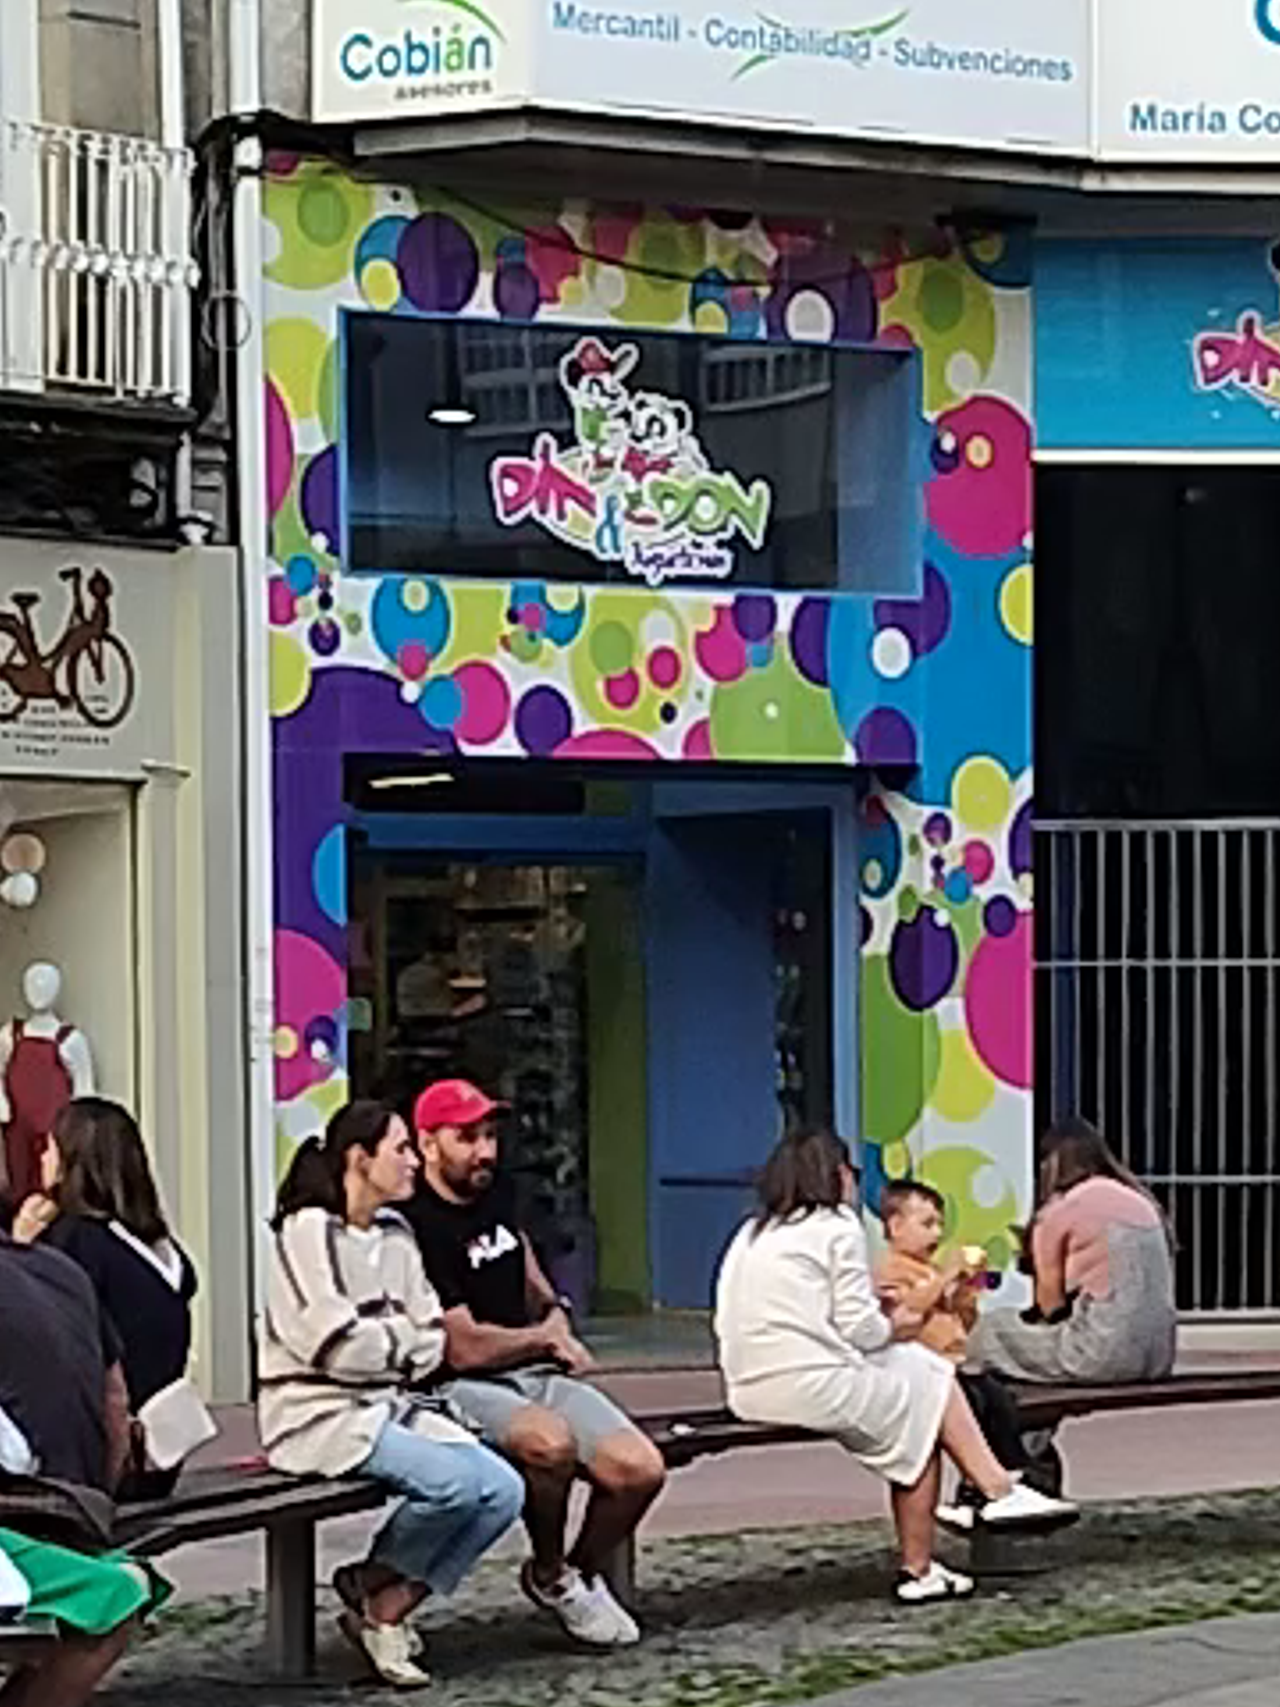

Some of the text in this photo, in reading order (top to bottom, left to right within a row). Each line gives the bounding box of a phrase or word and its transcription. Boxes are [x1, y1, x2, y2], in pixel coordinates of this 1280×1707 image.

[340, 24, 492, 81] Cobián
[553, 1, 679, 41] Mercantil
[705, 19, 870, 61] Contabilidad
[894, 39, 1072, 81] Subvenciones
[1130, 102, 1226, 134] María
